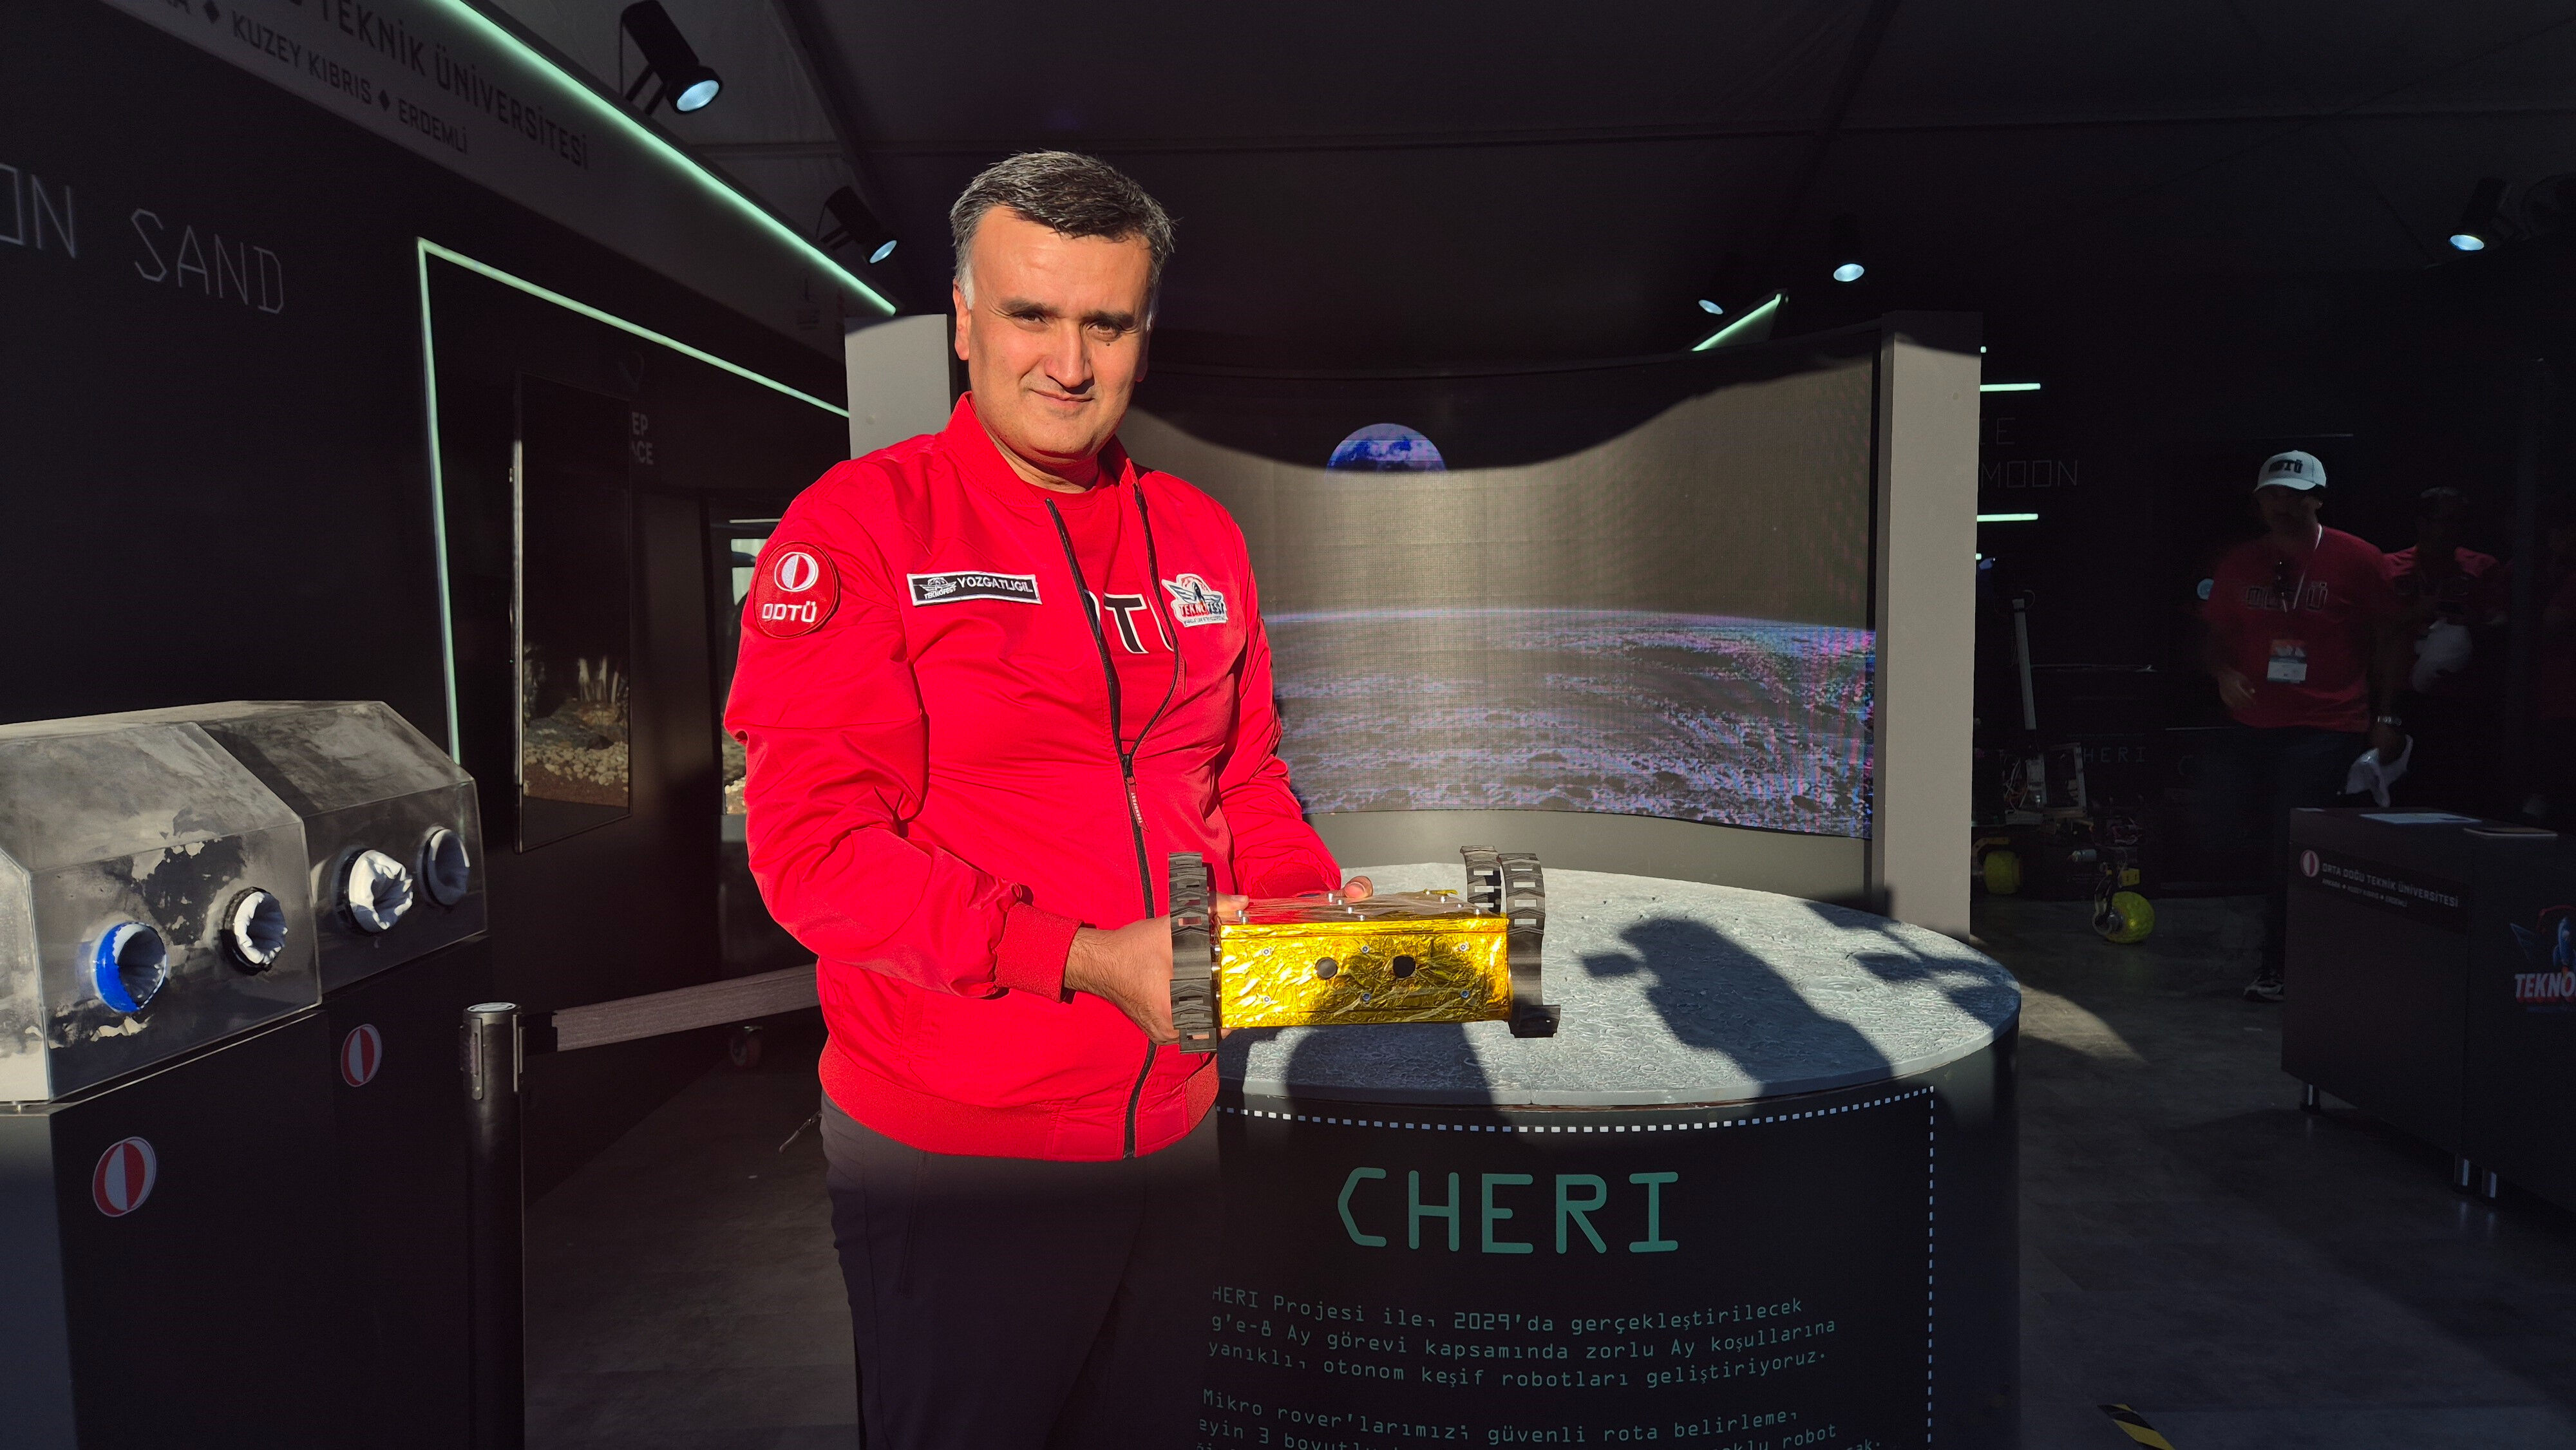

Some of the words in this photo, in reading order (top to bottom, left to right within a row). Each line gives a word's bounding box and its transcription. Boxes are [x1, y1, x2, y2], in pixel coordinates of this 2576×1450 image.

[232, 10, 301, 68] KUZEY
[308, 50, 372, 106] KIBRIS
[397, 98, 468, 155] ERDEMLİ
[435, 42, 589, 170] ÜNİVERSİTESİ
[131, 208, 285, 314] SAND
[761, 600, 818, 623] ODTÜ
[2322, 863, 2342, 876] ORTA
[2343, 869, 2365, 882] DOĞU
[2367, 874, 2397, 891] TEKNİK
[2398, 880, 2459, 908] ÜNİVERSİTESİ
[1337, 1166, 1680, 1255] CHERI
[1274, 1294, 1365, 1322] Projesi
[1453, 1312, 1555, 1332] 2029'da
[1571, 1297, 1803, 1336] gerçekleştirilecek
[1287, 1324, 1311, 1346] Ay
[1327, 1330, 1408, 1353] görevi
[1425, 1339, 1569, 1361] kapsamında
[1585, 1341, 1654, 1360] zorlu
[1671, 1338, 1695, 1359] Ay
[1710, 1319, 1836, 1353] koşullarına
[1323, 1358, 1405, 1382] otonom
[1421, 1366, 1484, 1389] keşif
[1502, 1370, 1629, 1388] robotları
[1646, 1351, 1826, 1389] geliştiriyoruz.
[1198, 1418, 1244, 1440] eyin
[1258, 1426, 1270, 1444] 3
[1782, 1423, 1837, 1449] robot
[1203, 1388, 1263, 1417] Mikro
[1487, 1425, 1586, 1446] güvenli
[1604, 1425, 1659, 1443] rota
[1673, 1410, 1799, 1439] belirleme,
